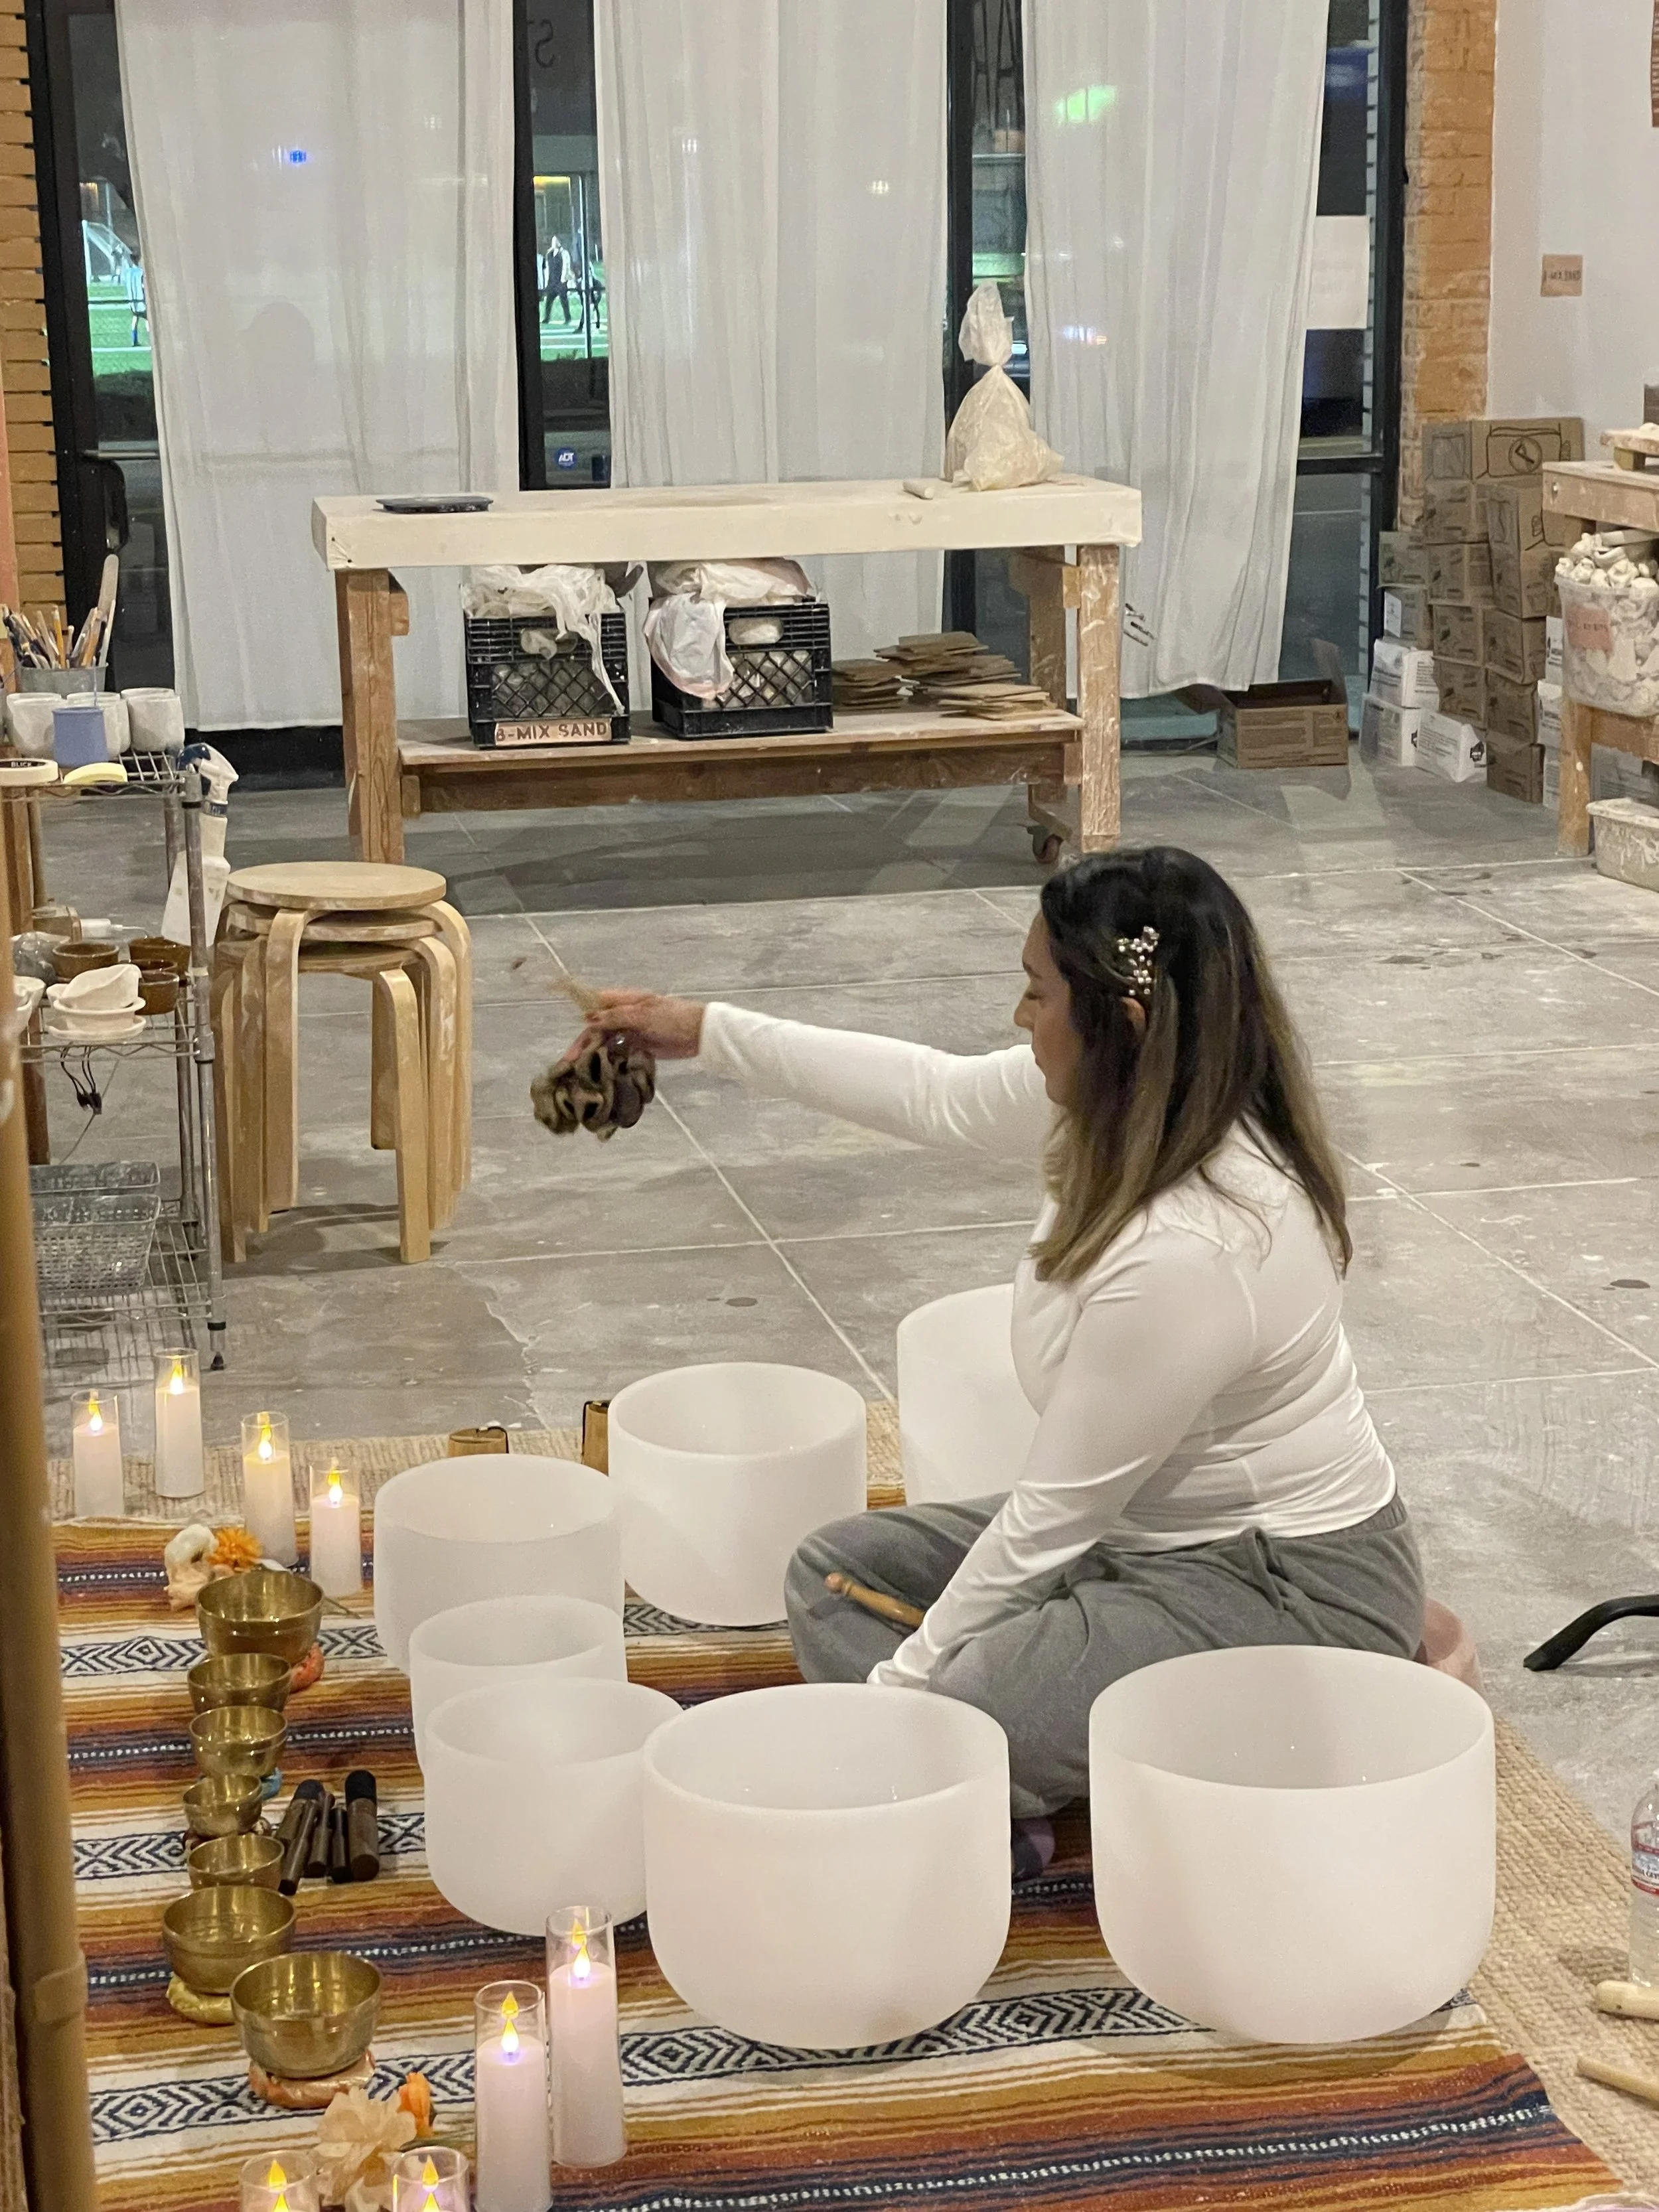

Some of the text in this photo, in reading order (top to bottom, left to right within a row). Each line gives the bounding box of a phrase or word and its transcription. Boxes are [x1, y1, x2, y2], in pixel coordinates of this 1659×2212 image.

[558, 453, 574, 462] ADT
[496, 721, 607, 742] B-MIX SAND
